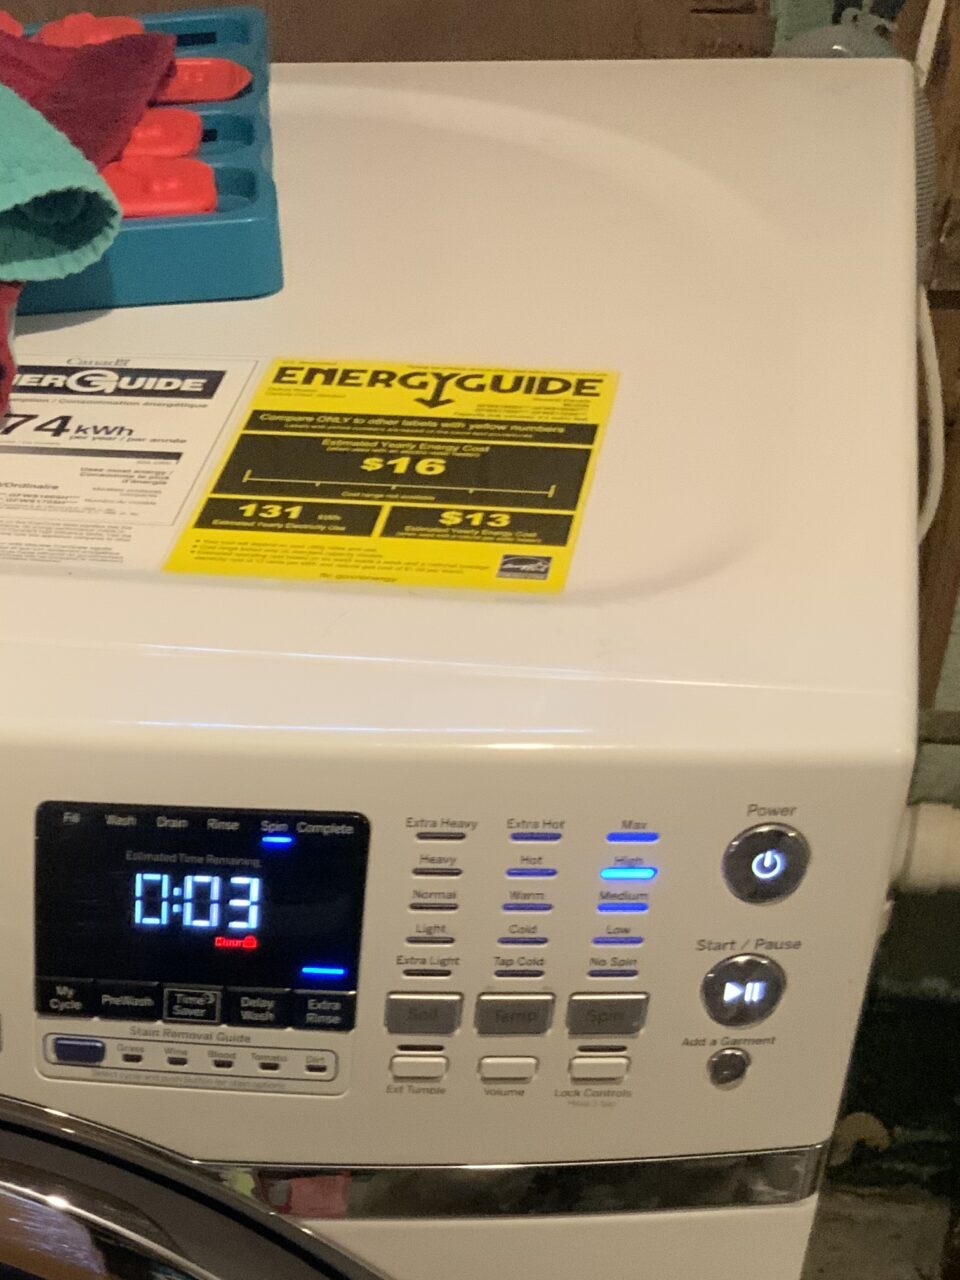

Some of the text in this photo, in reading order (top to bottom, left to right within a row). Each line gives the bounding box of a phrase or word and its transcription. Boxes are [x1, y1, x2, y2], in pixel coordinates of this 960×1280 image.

[272, 366, 604, 399] ENERGYGUIDE
[259, 413, 315, 424] Compare
[316, 414, 353, 424] ONLY
[353, 416, 366, 425] to
[367, 416, 399, 426] other
[401, 418, 438, 428] labels
[440, 421, 466, 429] with
[469, 423, 508, 432] yellow
[510, 424, 566, 433] numbers
[74, 424, 134, 436] kWh
[321, 438, 378, 448] Estimated
[381, 440, 417, 450] Yearly
[419, 442, 459, 452] Energy
[461, 444, 490, 453] Cost
[360, 456, 447, 475] $16
[239, 503, 304, 519] 131
[438, 510, 512, 527] $13
[746, 803, 798, 817] Power
[105, 814, 138, 827] Wash
[156, 815, 189, 829] Drain
[206, 818, 240, 832] Rinse
[260, 820, 289, 834] Spin
[405, 816, 478, 831] Extra Heavy
[506, 818, 566, 830] Extra Hot
[621, 820, 648, 830] Max
[296, 821, 355, 836] Complete
[125, 850, 263, 869] Estimated Time Remaining
[419, 854, 457, 866] Heavy
[520, 855, 544, 865] Hot
[134, 872, 261, 930] 0:03
[412, 889, 457, 900] Normal
[509, 890, 545, 900] Warm
[599, 891, 649, 901] Medium
[415, 923, 446, 936] Light
[508, 924, 538, 934] Cold
[605, 925, 631, 934] Low
[695, 938, 802, 951] Start / Pause
[395, 955, 460, 967] Extra Light
[493, 956, 545, 968] Tap Cold
[589, 957, 638, 968] No Spin
[48, 998, 84, 1011] Cycle
[240, 996, 275, 1010] Delay
[306, 999, 341, 1011] Extra
[305, 1013, 341, 1025] Rinse
[129, 1025, 252, 1044] Stain Removal Guide
[681, 1036, 777, 1047] Add a Garment
[483, 1087, 525, 1097] Volume
[554, 1088, 633, 1098] Lock Controls
